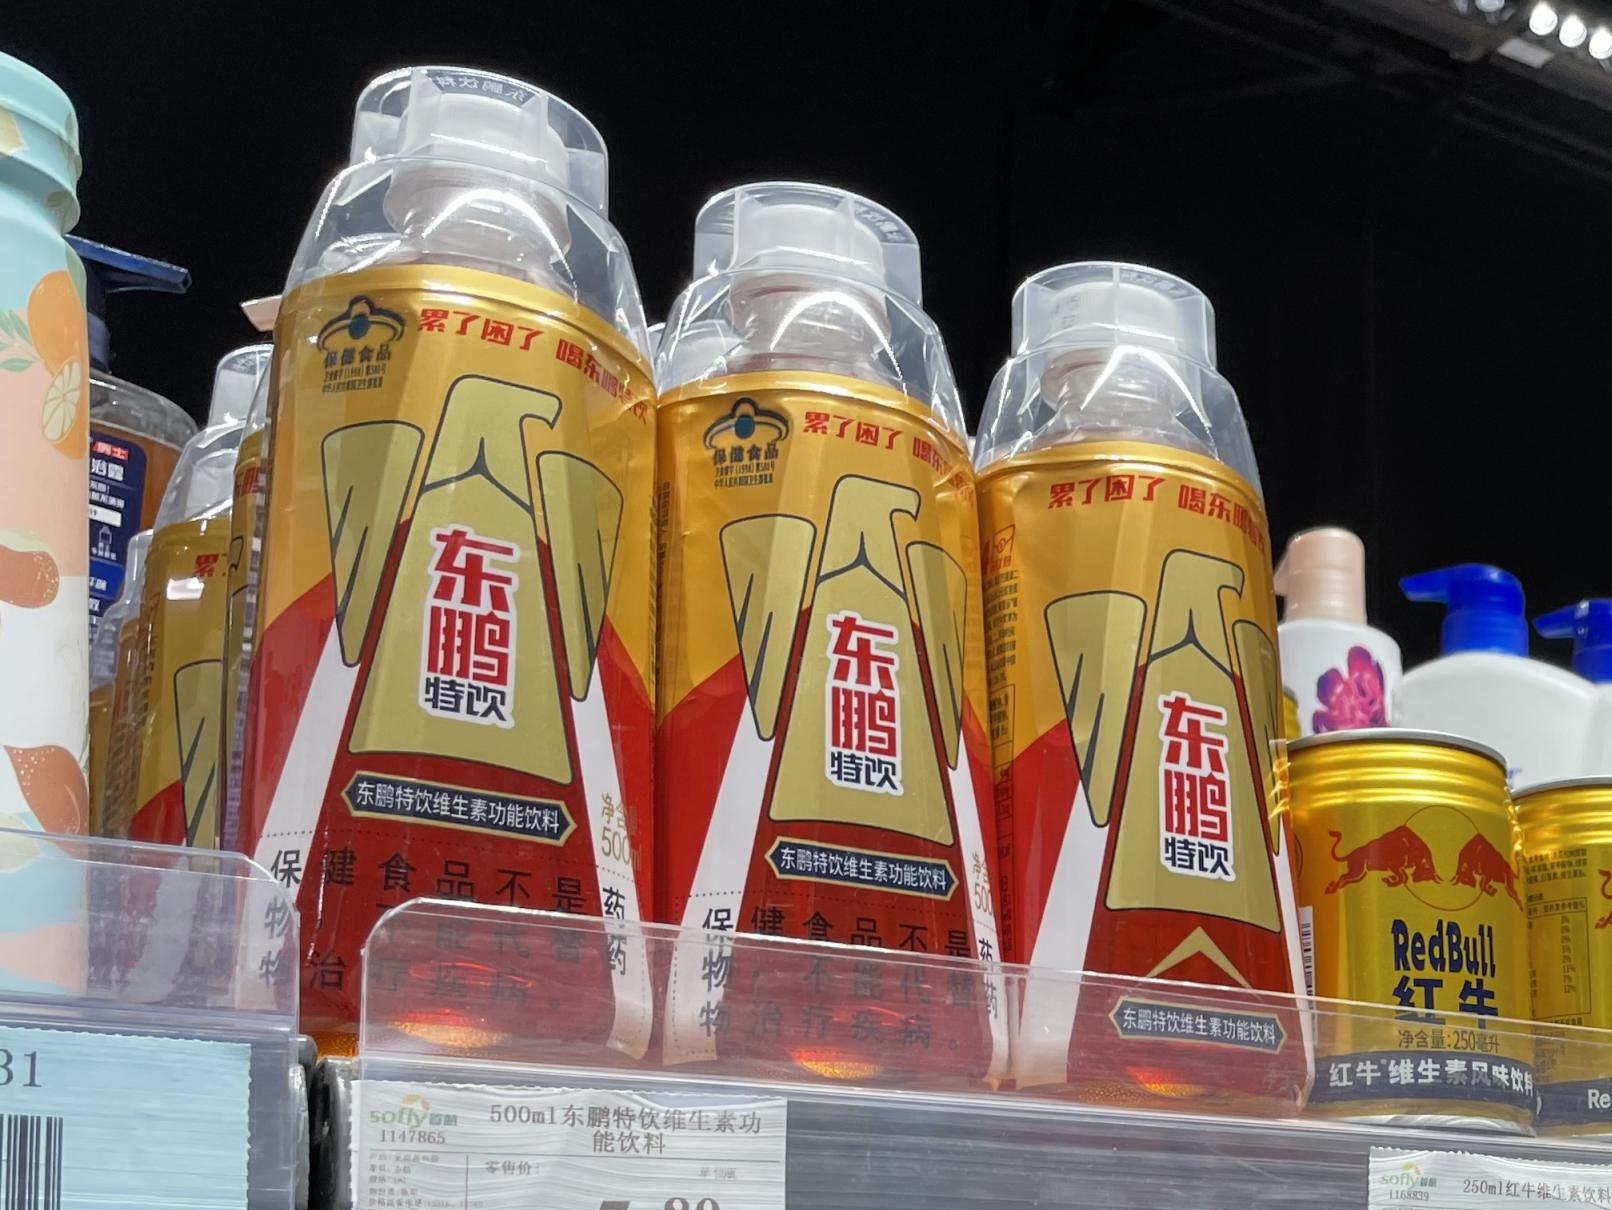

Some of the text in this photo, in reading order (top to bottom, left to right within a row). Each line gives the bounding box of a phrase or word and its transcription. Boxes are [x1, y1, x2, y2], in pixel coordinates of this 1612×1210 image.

[418, 308, 544, 351] 累了困了
[803, 411, 903, 450] 累了困了
[712, 443, 779, 467] 保健食品
[1048, 474, 1165, 509] 累了困了
[427, 528, 518, 687] 东鹏
[425, 676, 509, 721] 特饮
[830, 612, 897, 758] 东鹏
[829, 747, 900, 792] 特饮
[1161, 695, 1229, 843] 东鹏
[357, 780, 560, 834] 东鹏特饮维生素功能饮料
[780, 846, 947, 891] 东鹏特饮维生素功能饮料
[1164, 837, 1231, 877] 特饮
[262, 893, 627, 977] 物不能代替药
[1391, 919, 1498, 979] RedBull
[1393, 976, 1499, 1030] 红牛
[1122, 1007, 1276, 1044] 东鹏特饮维生素功能饮料
[369, 1107, 427, 1129] sofly
[380, 1129, 446, 1145] 1147865
[489, 1103, 762, 1134] 500ml东鹏特饮维生素功
[592, 1132, 666, 1154] 能饮料
[1463, 1178, 1612, 1204] 250ml红牛维生素饮料
